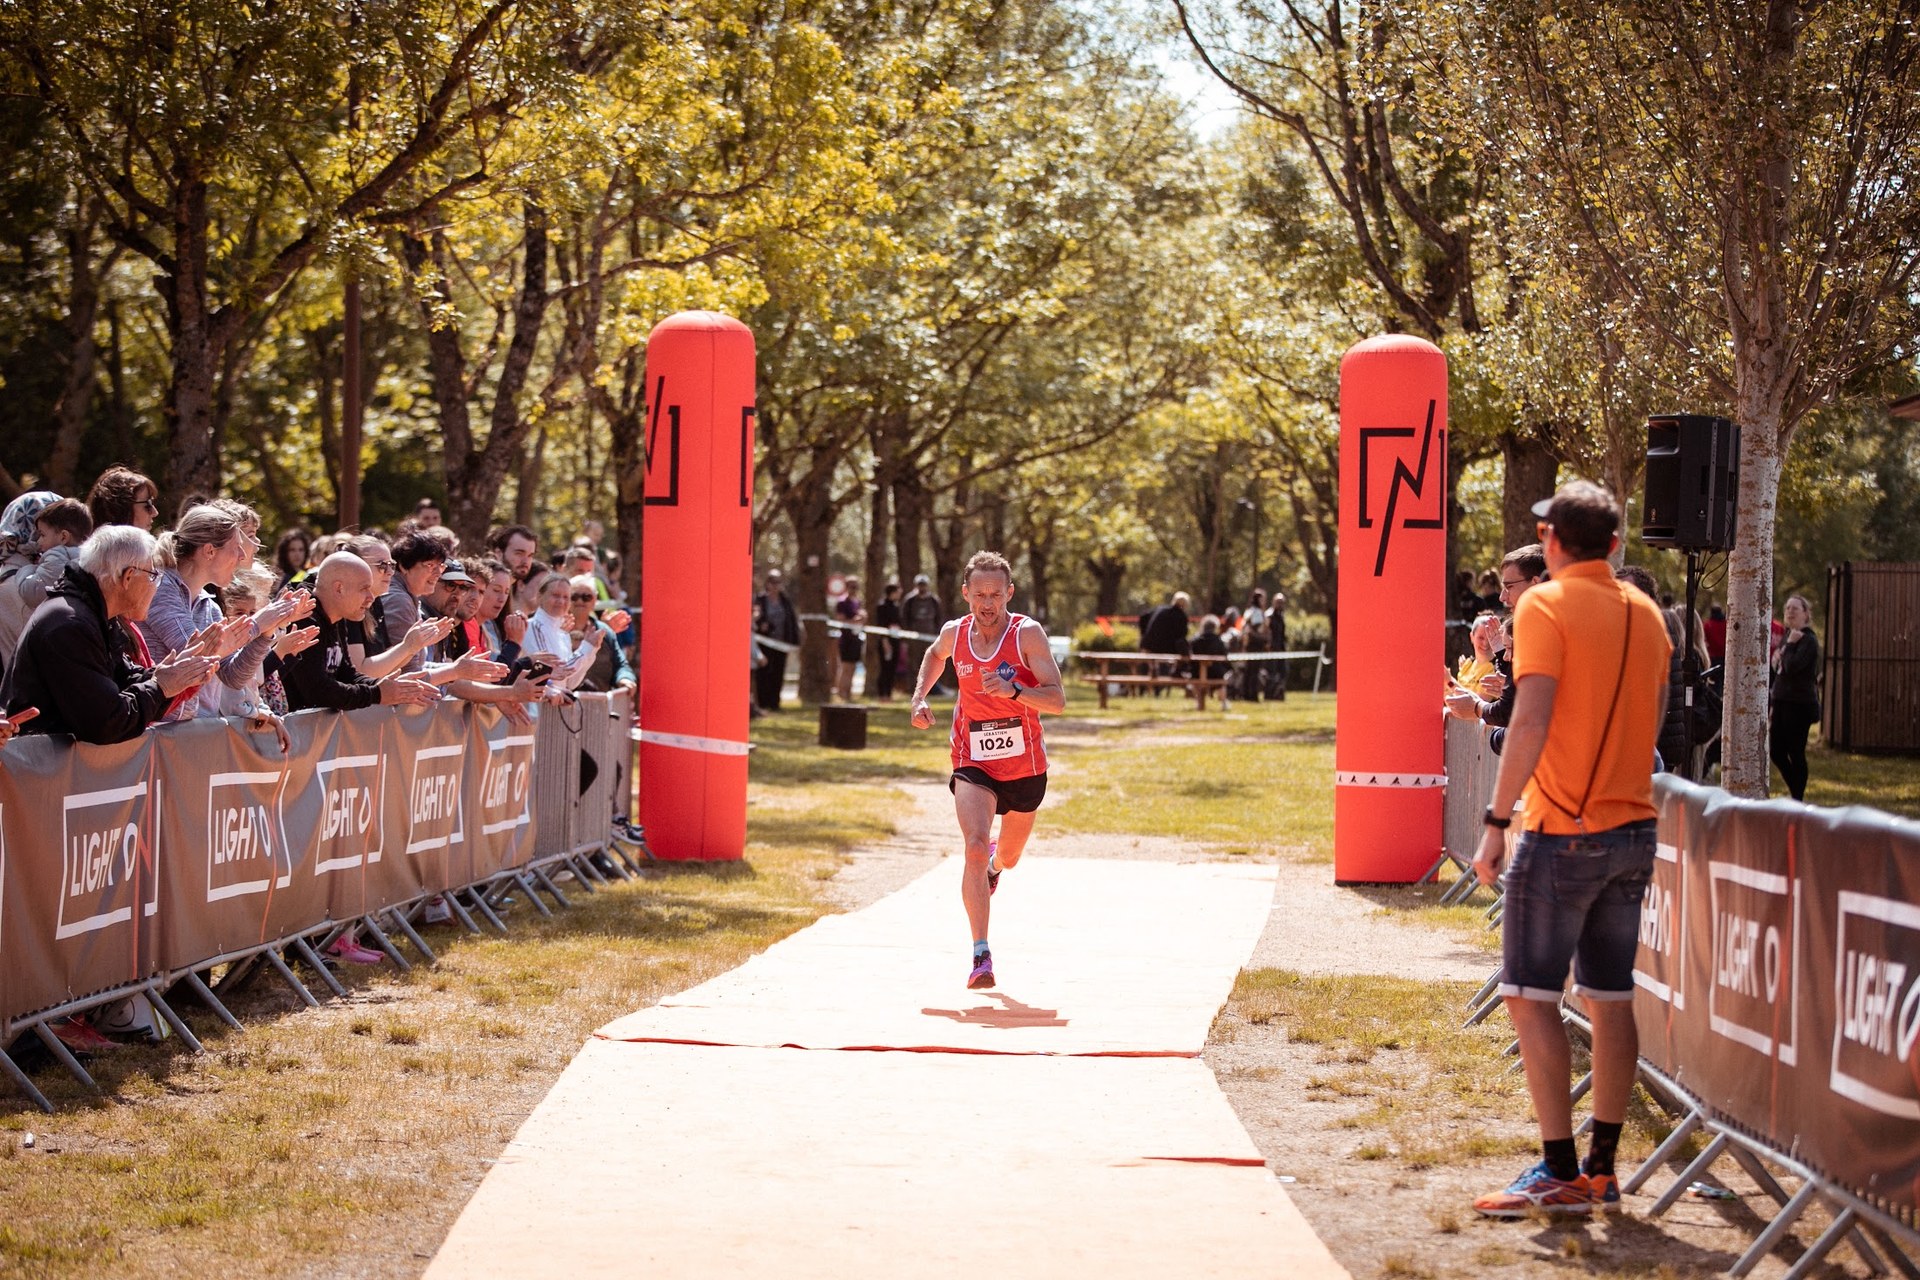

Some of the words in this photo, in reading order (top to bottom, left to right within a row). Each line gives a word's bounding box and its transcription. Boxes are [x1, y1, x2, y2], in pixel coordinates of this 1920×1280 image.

[980, 736, 1014, 751] 1026
[322, 788, 359, 842] LIGHT
[414, 775, 446, 824] LIGHT
[71, 828, 121, 897] LIGHT
[215, 806, 258, 865] LIGHT
[1718, 911, 1760, 999] LIGHT
[1844, 950, 1907, 1056] LIGHT
